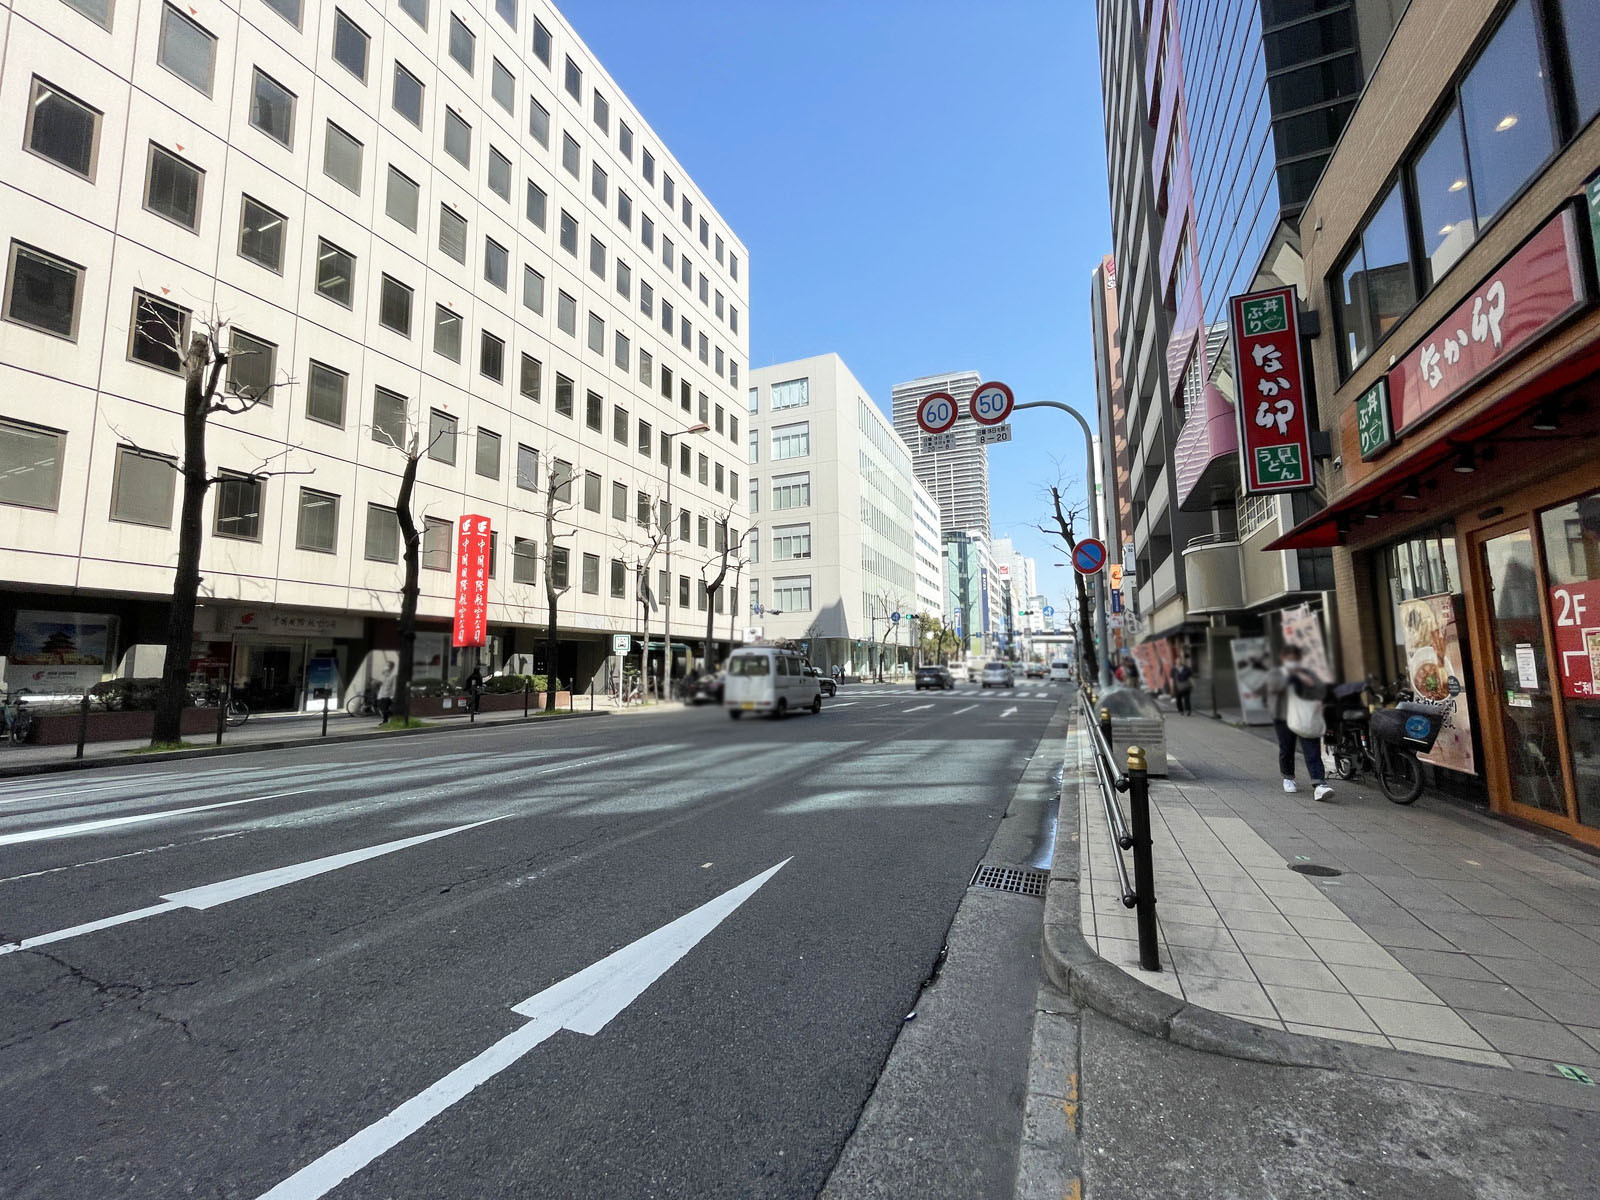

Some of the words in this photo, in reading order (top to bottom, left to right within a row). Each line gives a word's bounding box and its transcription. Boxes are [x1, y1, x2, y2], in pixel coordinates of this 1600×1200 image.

[1419, 279, 1505, 389] なか卯
[980, 393, 1004, 414] 50
[1251, 343, 1295, 436] なか卯
[926, 403, 949, 423] 60
[1258, 449, 1294, 480] うどん
[1554, 589, 1587, 626] 2F
